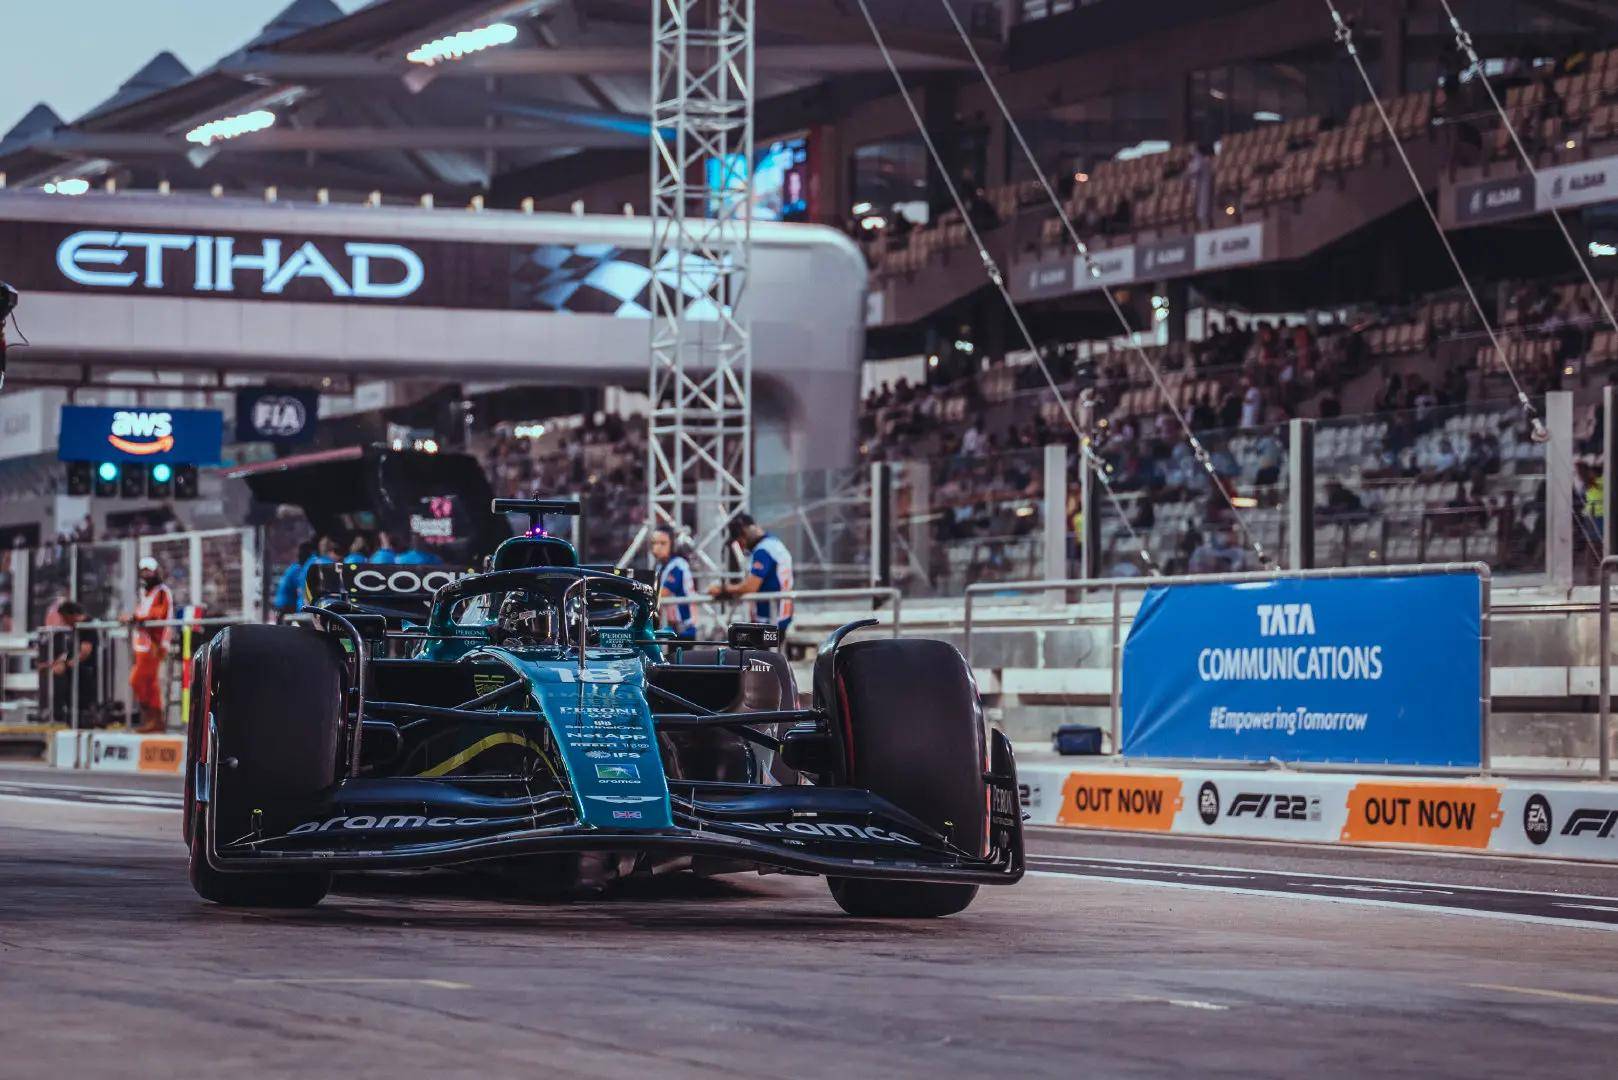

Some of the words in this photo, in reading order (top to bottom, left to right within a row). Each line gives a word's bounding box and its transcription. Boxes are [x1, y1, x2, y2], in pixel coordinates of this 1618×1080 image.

[56, 230, 424, 298] ETIHAD
[111, 411, 172, 437] aws
[254, 403, 300, 429] FIA
[1257, 603, 1316, 636] TATA
[1198, 645, 1383, 681] COMMUNICATIONS
[1210, 706, 1369, 736] #EmpoweringTomorrow
[567, 732, 647, 740] NetApp
[1076, 787, 1114, 812] OUT
[1118, 788, 1163, 815] NOW
[1274, 795, 1307, 820] 22
[1528, 804, 1548, 823] EA
[286, 815, 490, 835] aramco
[1365, 798, 1411, 826] OUT
[1418, 799, 1476, 831] NOW
[731, 822, 921, 846] aramco
